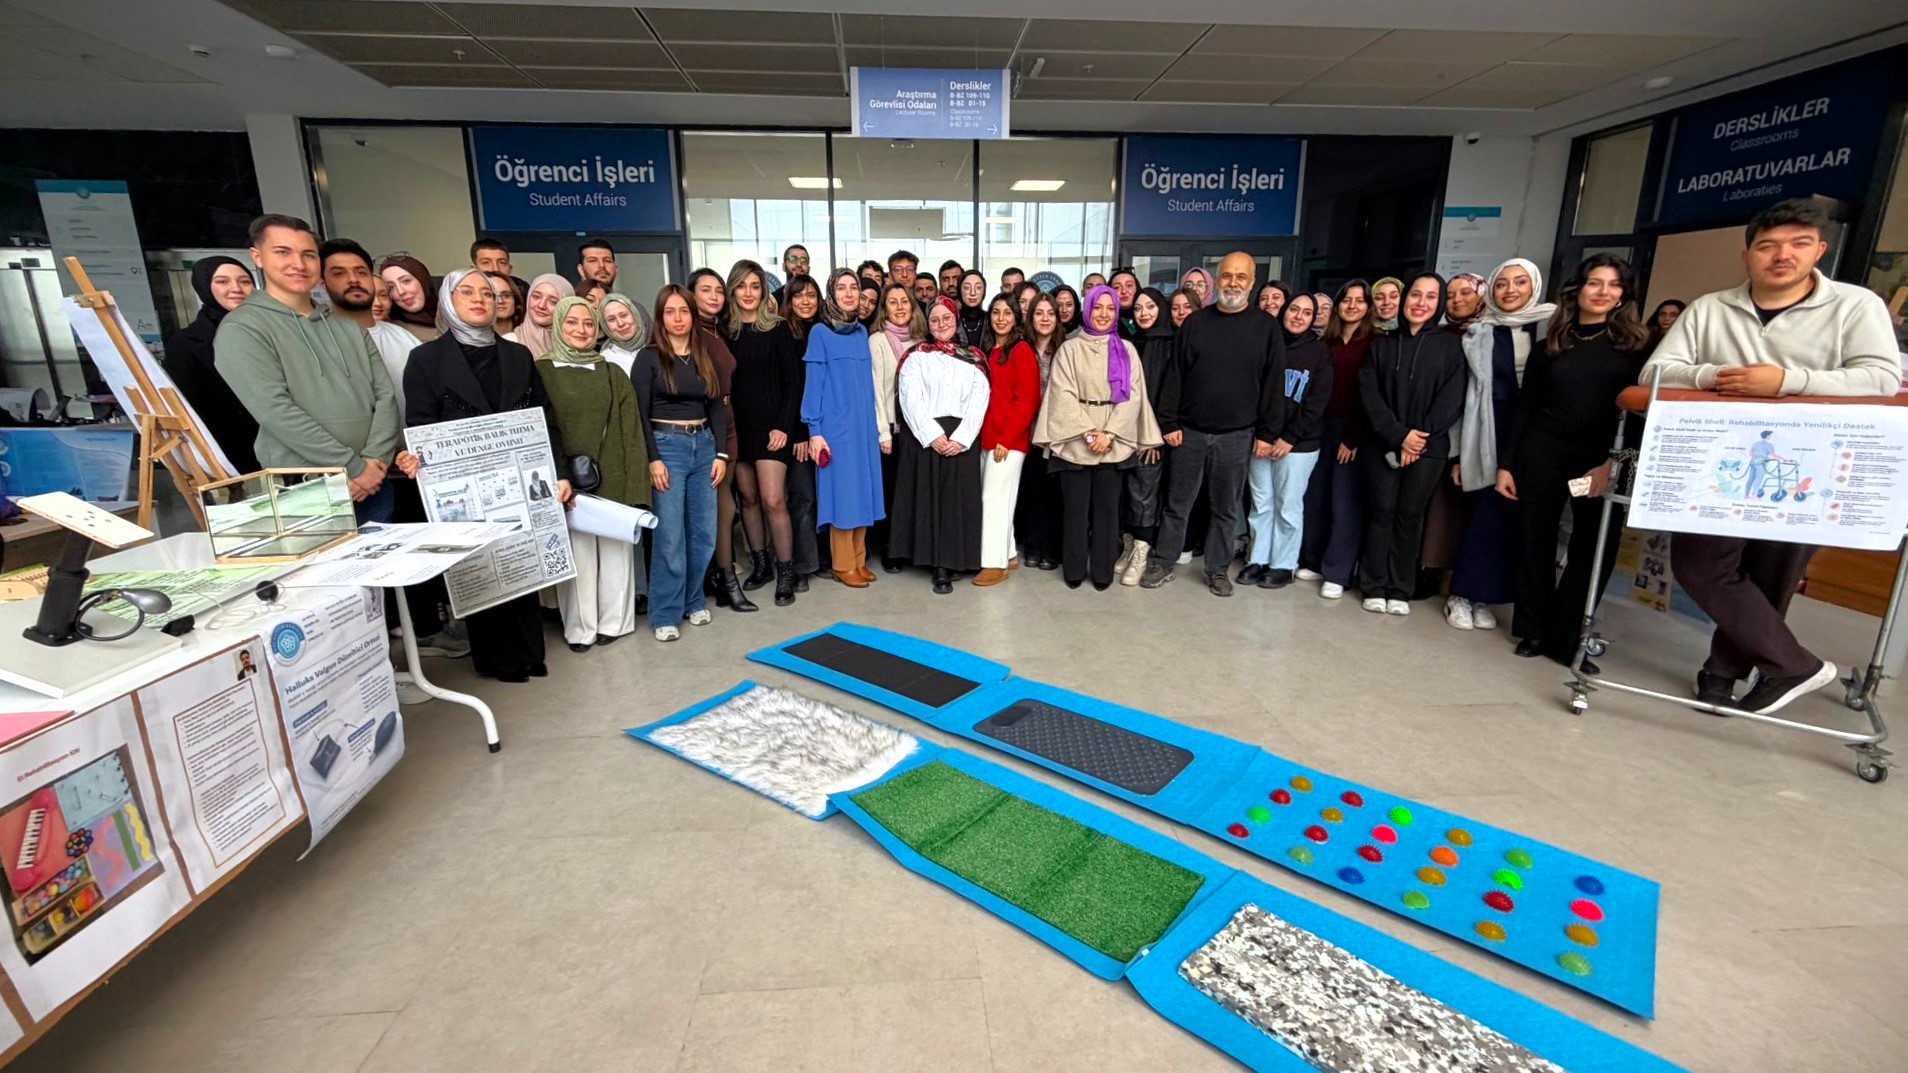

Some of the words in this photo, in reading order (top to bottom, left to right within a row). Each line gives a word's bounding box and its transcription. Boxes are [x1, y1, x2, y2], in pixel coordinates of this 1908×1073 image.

[896, 90, 937, 100] Araştırma
[950, 80, 991, 90] Derslikler
[869, 99, 906, 109] Görevlisi
[907, 100, 937, 110] Odaları
[1713, 97, 1830, 139] DERSLİKLER
[1730, 127, 1800, 152] Classrooms
[494, 155, 589, 188] Öğrenci
[595, 155, 655, 188] İşleri
[1141, 163, 1224, 194] Öğrenci
[1231, 164, 1285, 195] İşleri
[1677, 147, 1851, 193] LABORATUVARLAR
[529, 192, 581, 206] Student
[584, 192, 627, 207] Affairs
[1167, 199, 1213, 212] Student
[1216, 199, 1254, 213] Affairs
[1803, 422, 1841, 430] Yenilikçi
[285, 675, 314, 695] Halluks
[314, 660, 337, 681] Valgus
